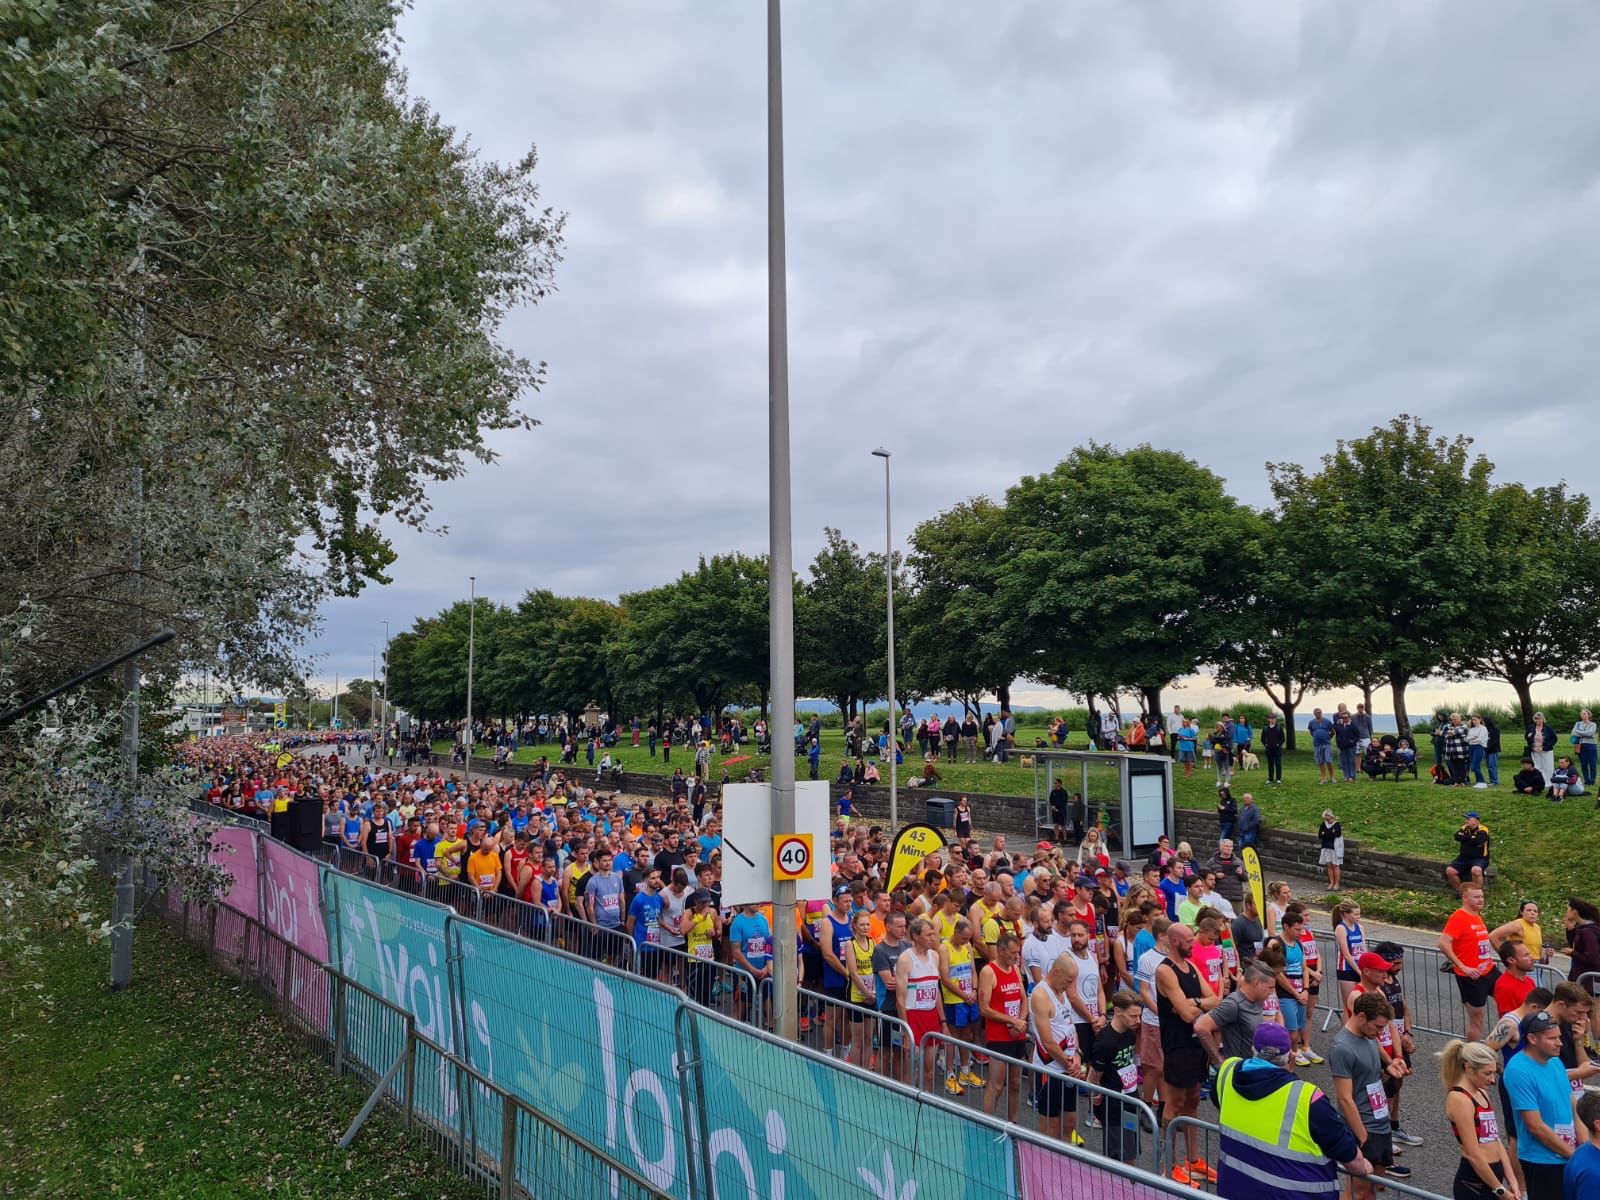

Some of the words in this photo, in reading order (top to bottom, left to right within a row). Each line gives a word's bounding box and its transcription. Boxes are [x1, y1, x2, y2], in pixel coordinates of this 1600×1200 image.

[908, 830, 926, 843] 45
[781, 848, 806, 865] 40
[899, 843, 926, 858] Mins
